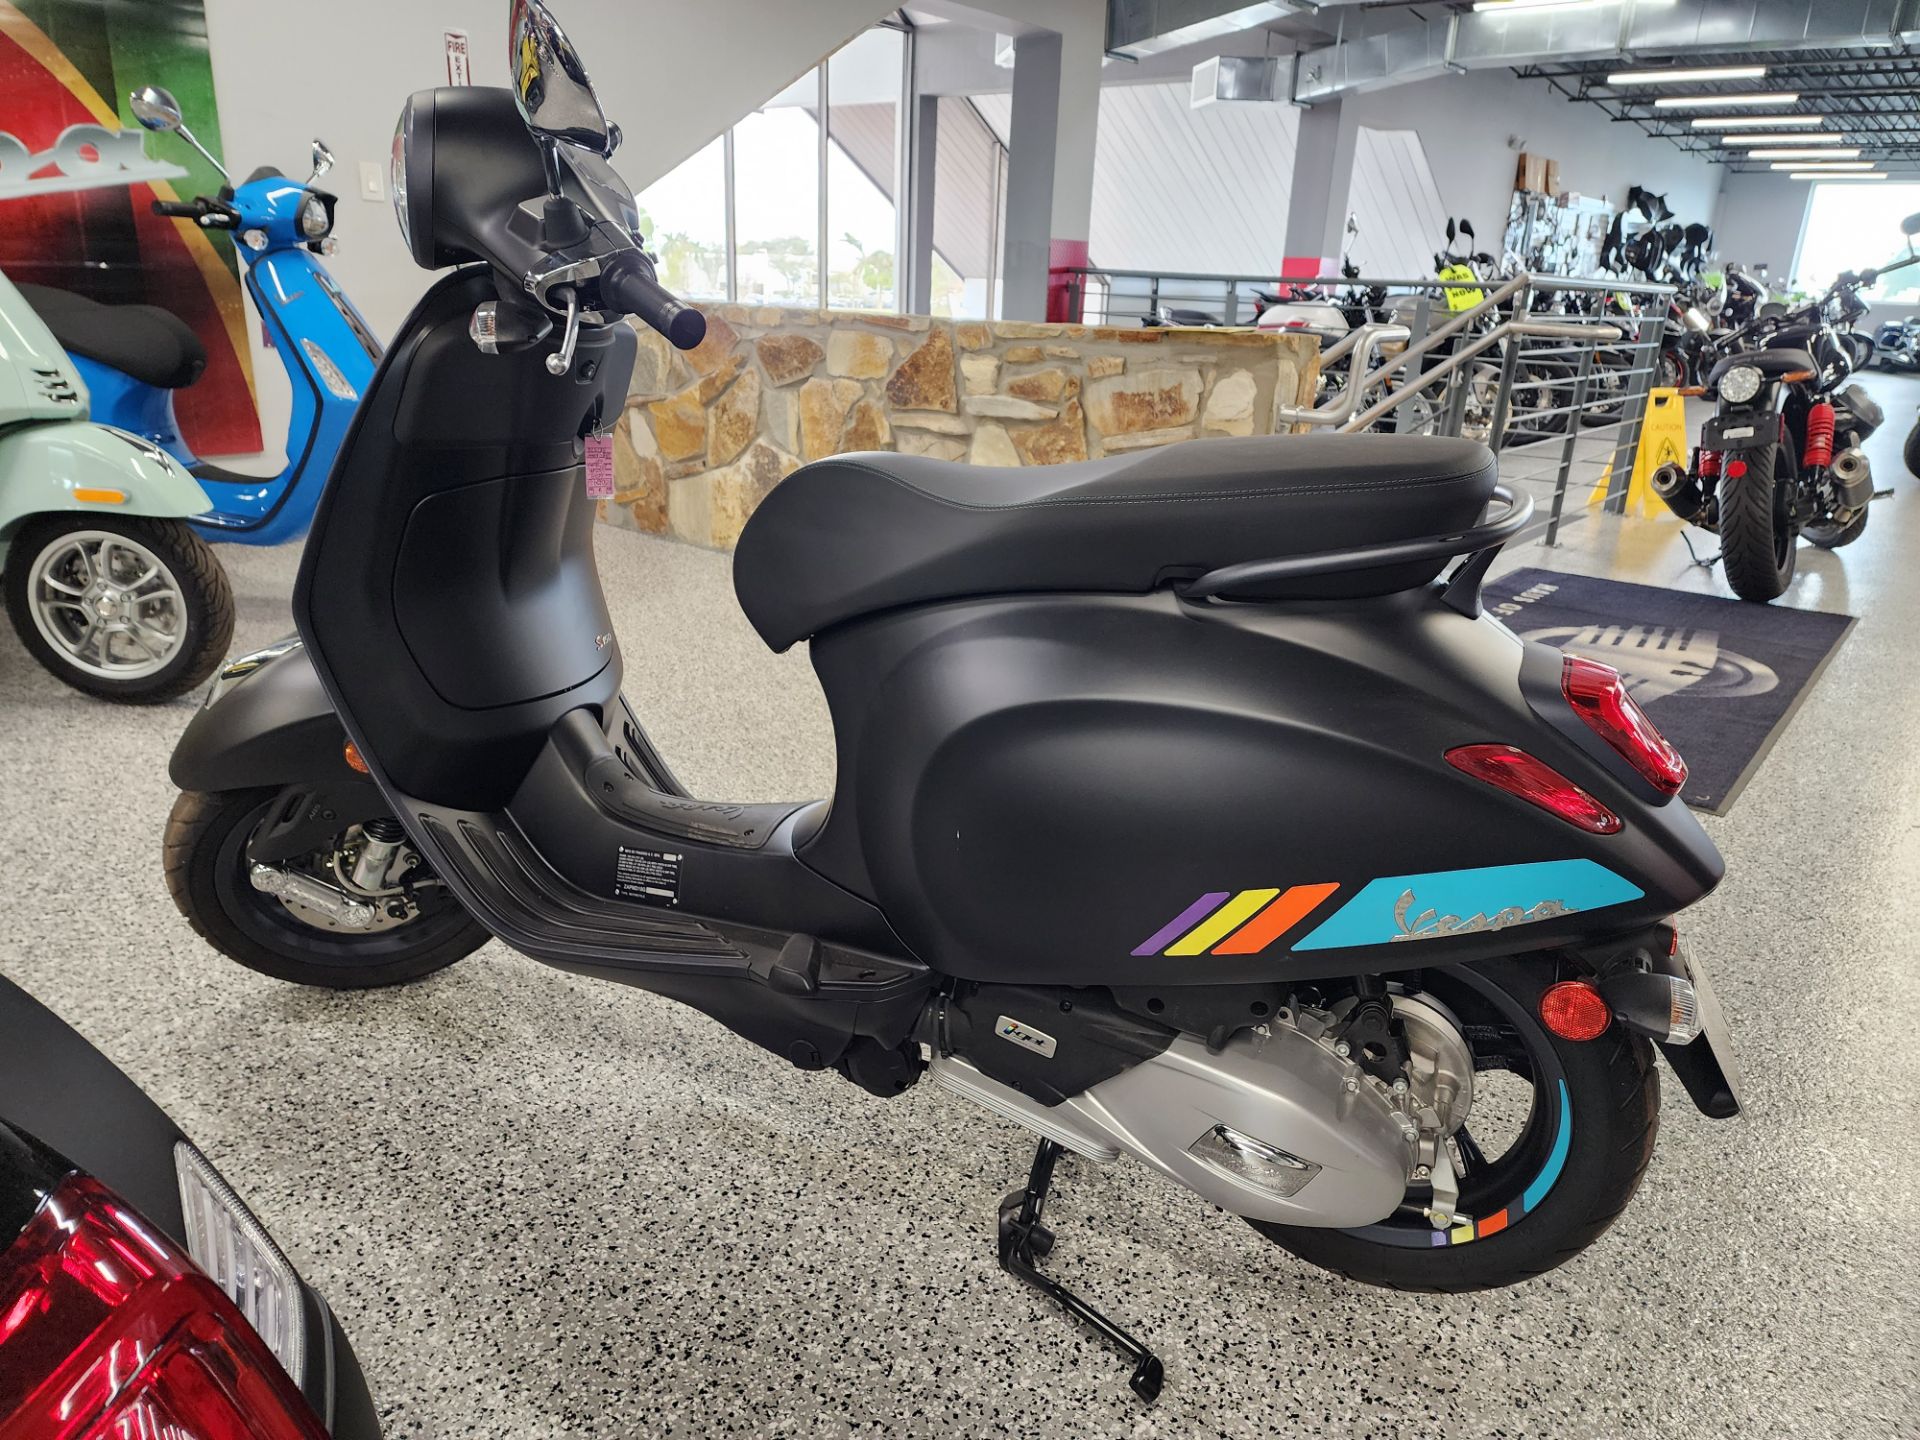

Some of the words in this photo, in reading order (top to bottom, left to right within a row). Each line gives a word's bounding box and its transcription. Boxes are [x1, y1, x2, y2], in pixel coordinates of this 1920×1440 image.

[447, 40, 466, 55] FIRE
[1650, 423, 1682, 432] CAUTION
[1390, 888, 1580, 943] Vespa
